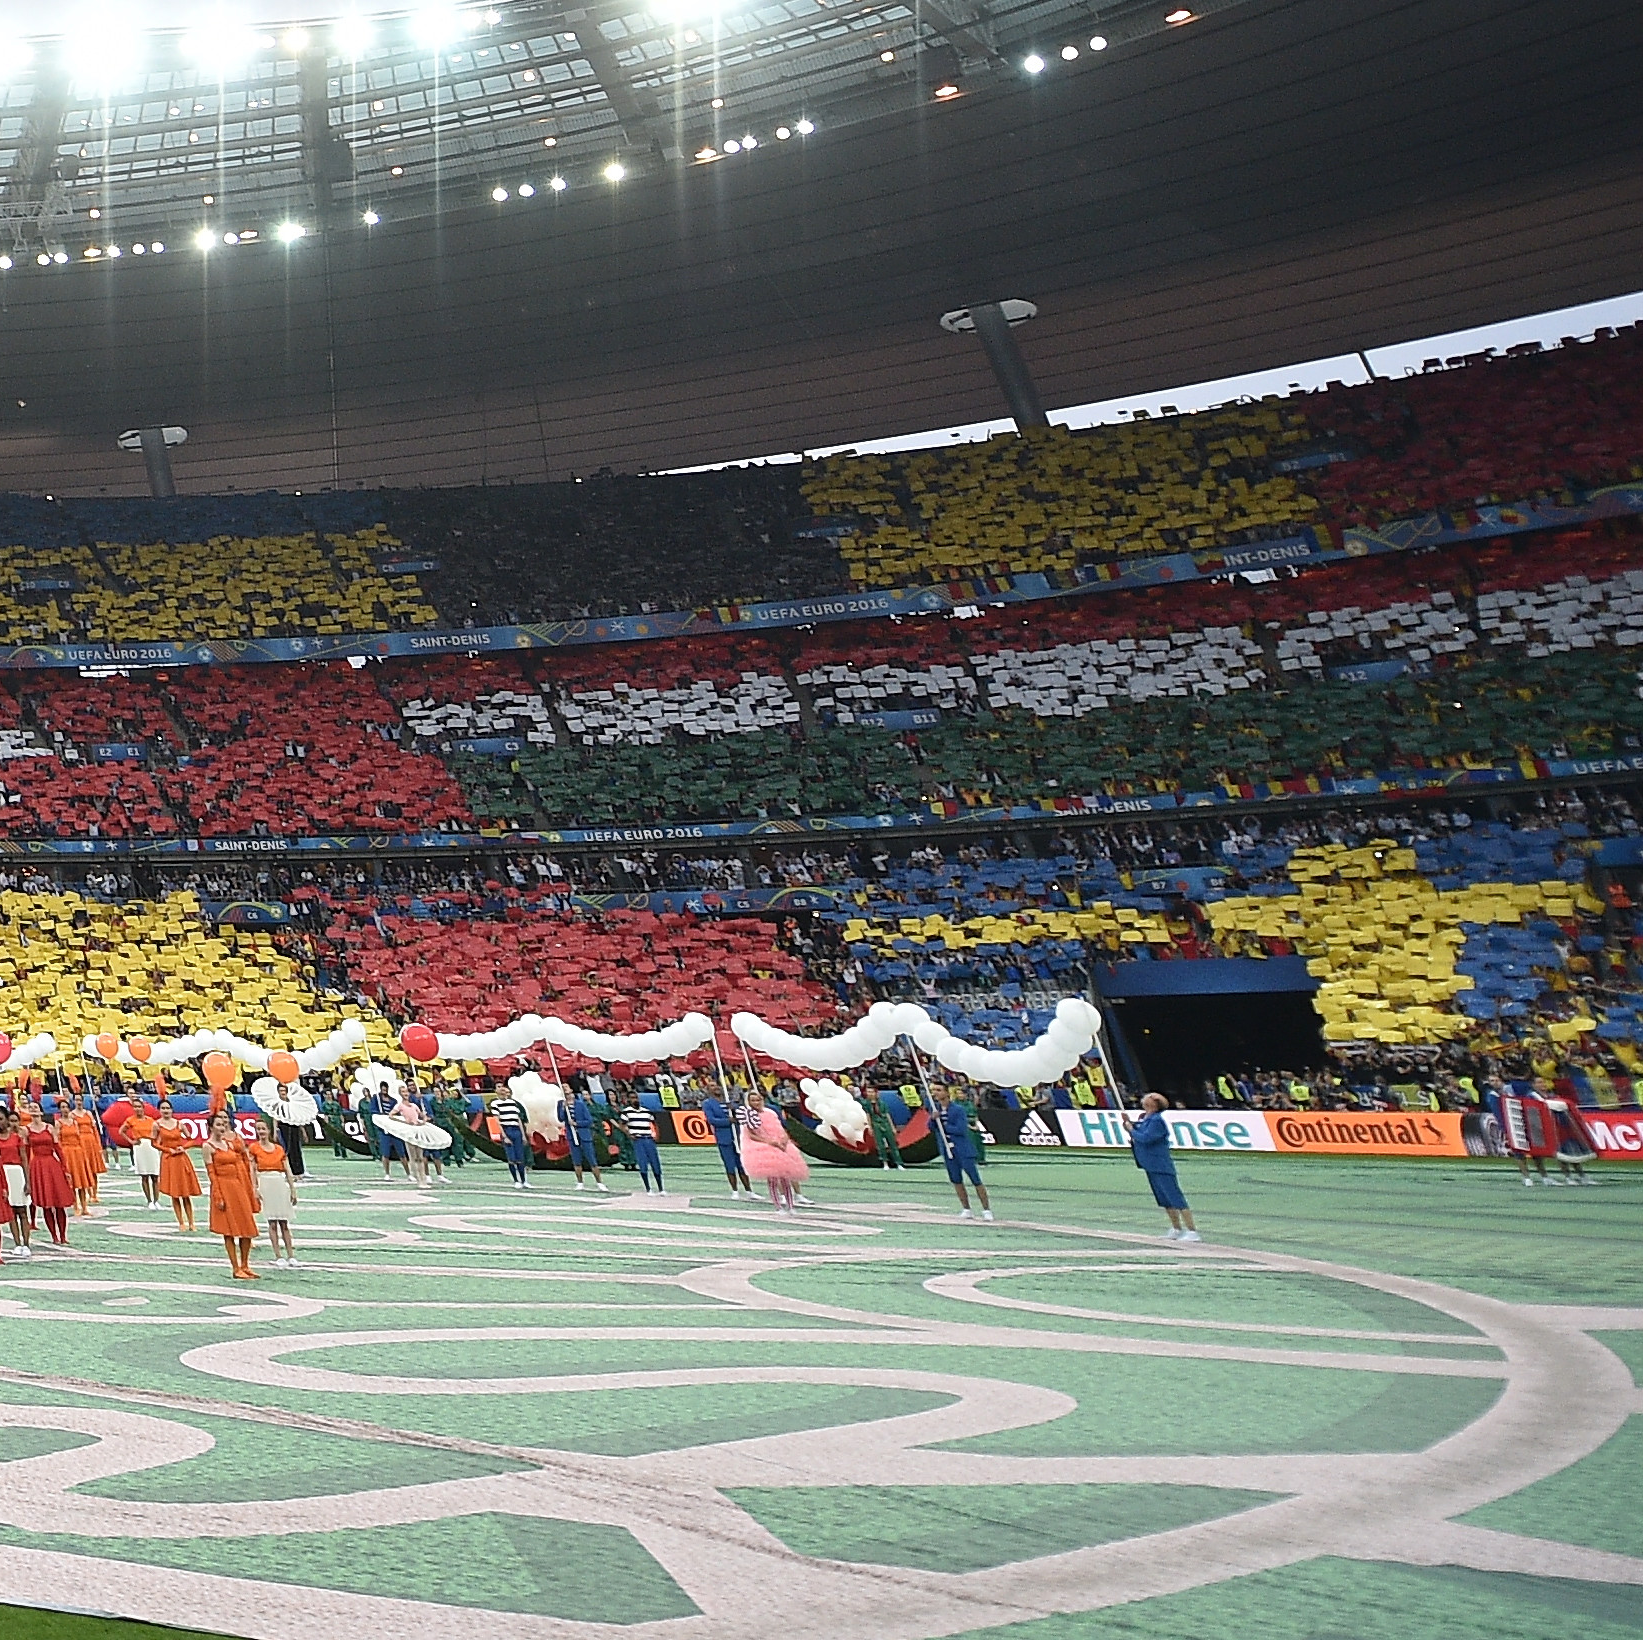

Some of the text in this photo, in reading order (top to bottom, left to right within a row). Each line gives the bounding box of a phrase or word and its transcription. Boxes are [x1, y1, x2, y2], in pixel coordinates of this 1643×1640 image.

[1223, 544, 1310, 567] INT-DENIS
[758, 598, 889, 621] UEFA EURO 2016
[411, 633, 491, 648] SAINT-DENIS
[68, 649, 102, 661] UEFA
[140, 648, 172, 659] 2016
[912, 714, 937, 724] B11
[99, 748, 140, 756] E2 E1
[1574, 760, 1630, 776] UEFA
[584, 826, 703, 842] UEFA EURO 2016
[215, 840, 287, 851] SAINT-DENIS
[1078, 1112, 1253, 1148] Hinse
[1276, 1115, 1425, 1148] Continental
[1585, 1121, 1643, 1151] Mc
[1019, 1133, 1062, 1146] adidas
